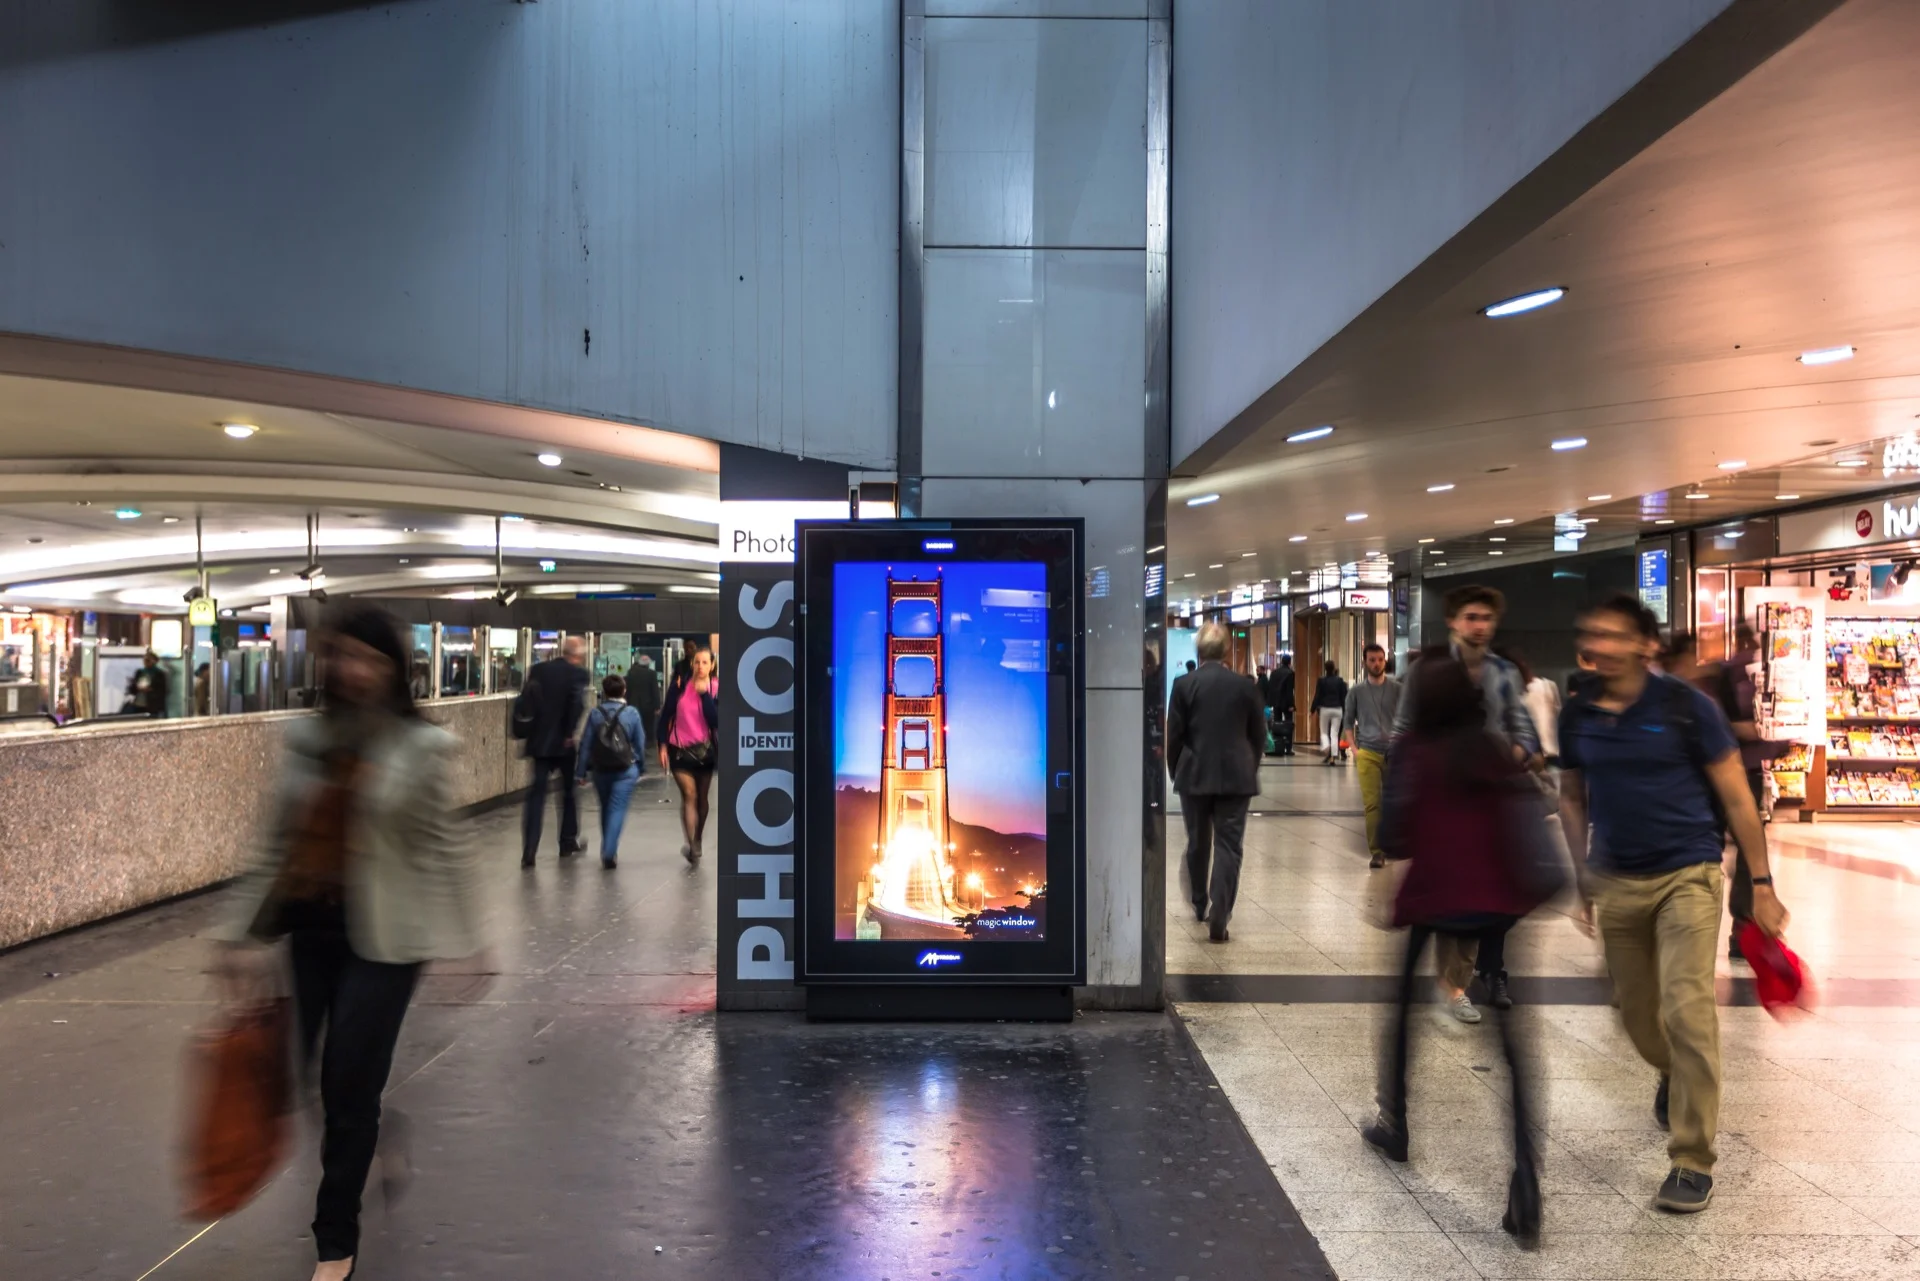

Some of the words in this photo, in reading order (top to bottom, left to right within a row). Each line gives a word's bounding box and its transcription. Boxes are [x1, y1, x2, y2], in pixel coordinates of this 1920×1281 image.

[1883, 497, 1920, 539] hu
[741, 735, 795, 748] IDENTI
[1001, 915, 1036, 926] window
